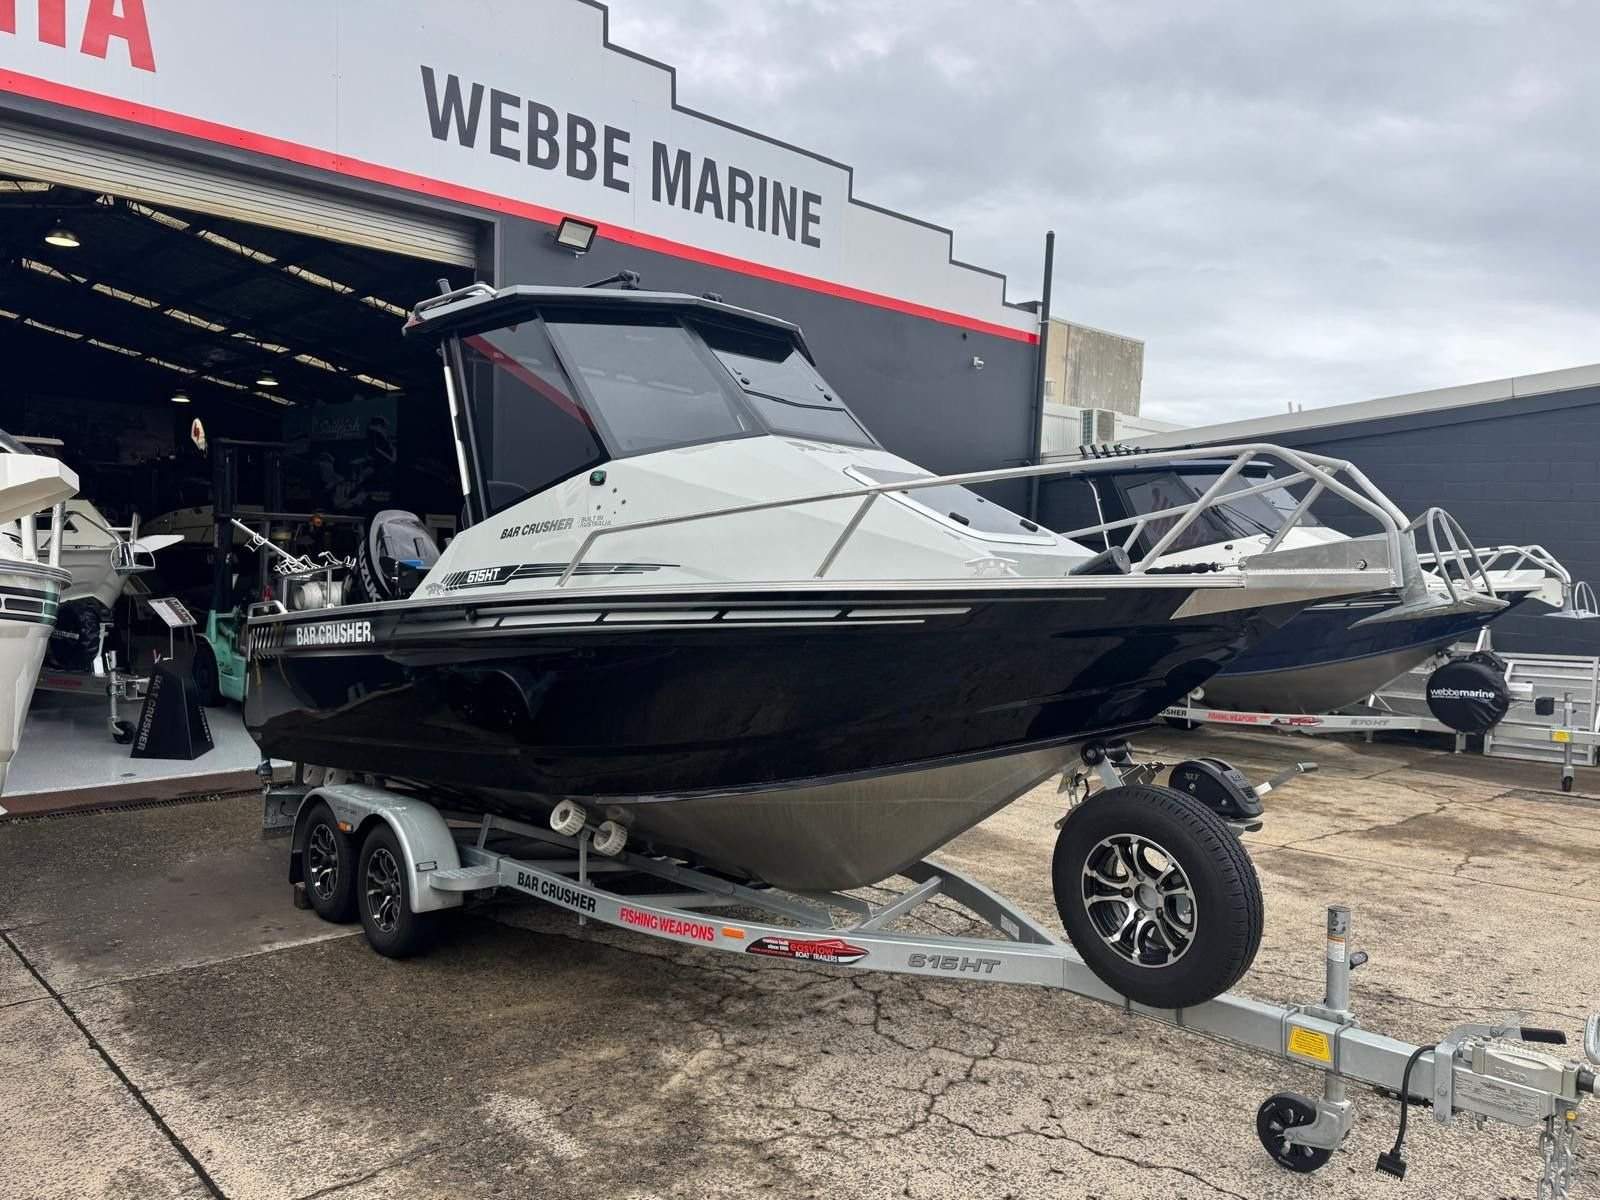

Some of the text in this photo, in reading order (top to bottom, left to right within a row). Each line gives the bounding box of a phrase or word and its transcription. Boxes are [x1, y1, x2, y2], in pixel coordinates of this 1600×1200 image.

[420, 64, 822, 249] WEBBE MARINE
[500, 518, 574, 539] BAR CRUSHER
[359, 540, 381, 601] SUZUK
[467, 568, 501, 583] 615HT
[296, 621, 371, 646] BAR CRUSHER
[1430, 688, 1495, 698] webbemarine
[137, 699, 157, 752] CRUSHER
[517, 872, 597, 913] BAR CRUSHER
[619, 907, 715, 942] FISHING WEAPONS
[908, 953, 1001, 973] 615HT
